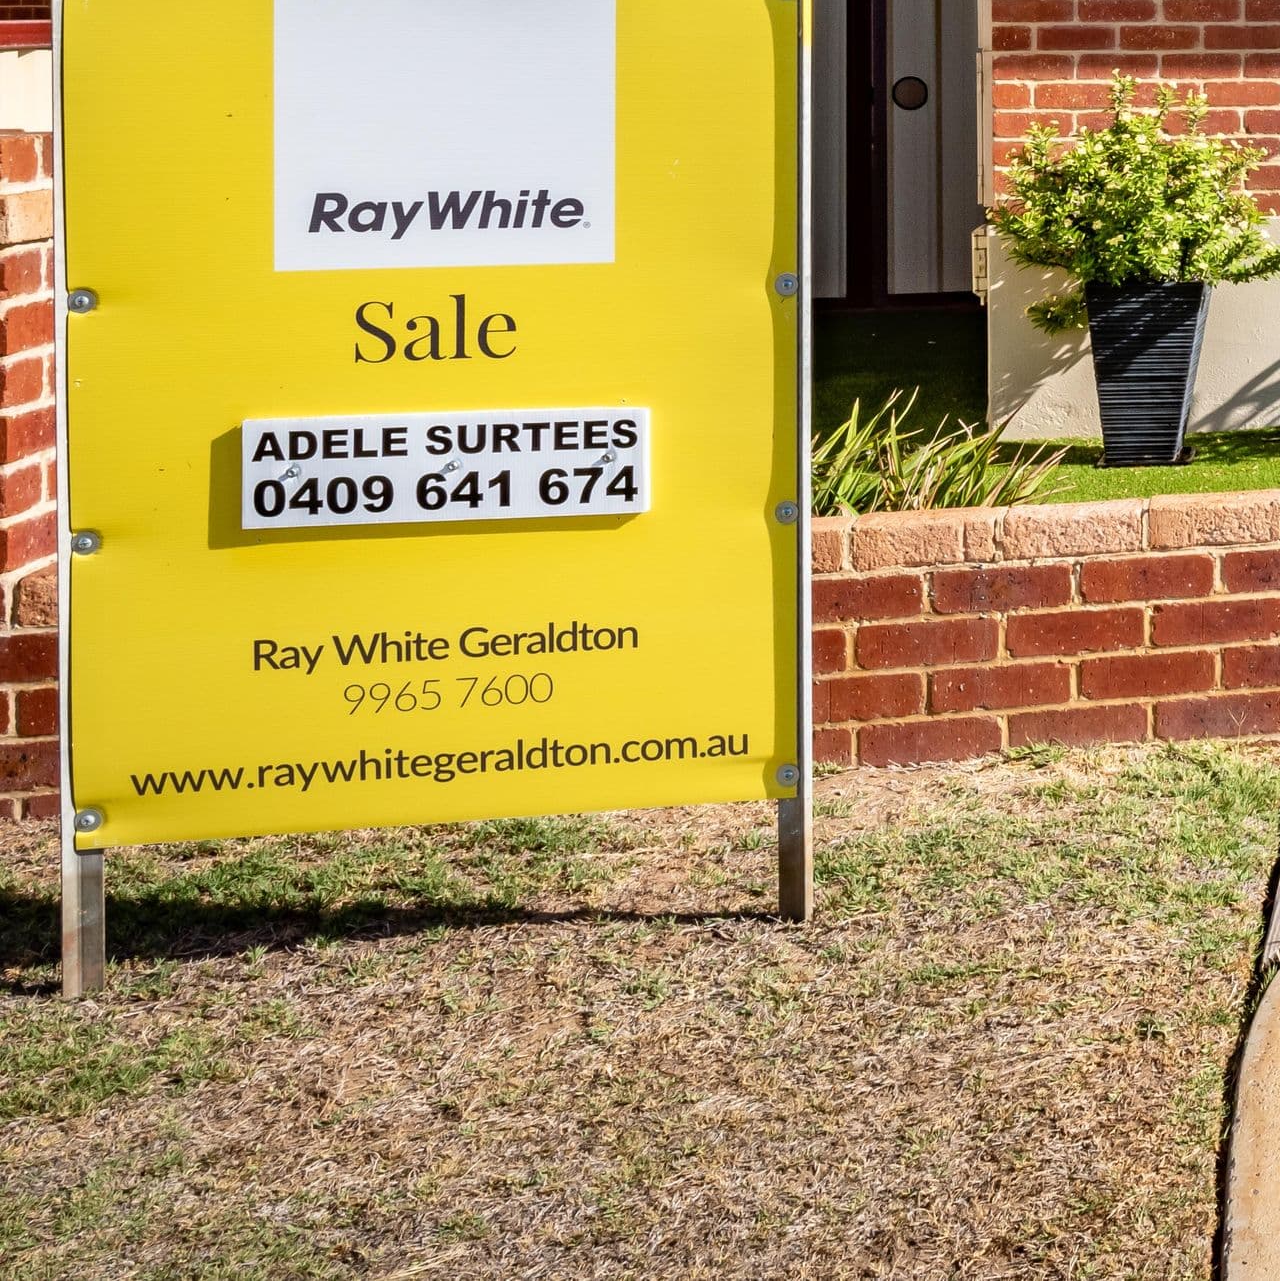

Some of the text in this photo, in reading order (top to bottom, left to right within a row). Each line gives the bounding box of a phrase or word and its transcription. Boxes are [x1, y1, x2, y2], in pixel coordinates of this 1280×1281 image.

[354, 294, 517, 364] Sale
[252, 419, 638, 462] ADELE SURTEES
[253, 466, 639, 518] 0409 641 674
[253, 620, 639, 675] Ray White Geraldton
[343, 671, 554, 716] 9965 7600
[130, 732, 750, 797] www.raywhitegeraldton.com.au
